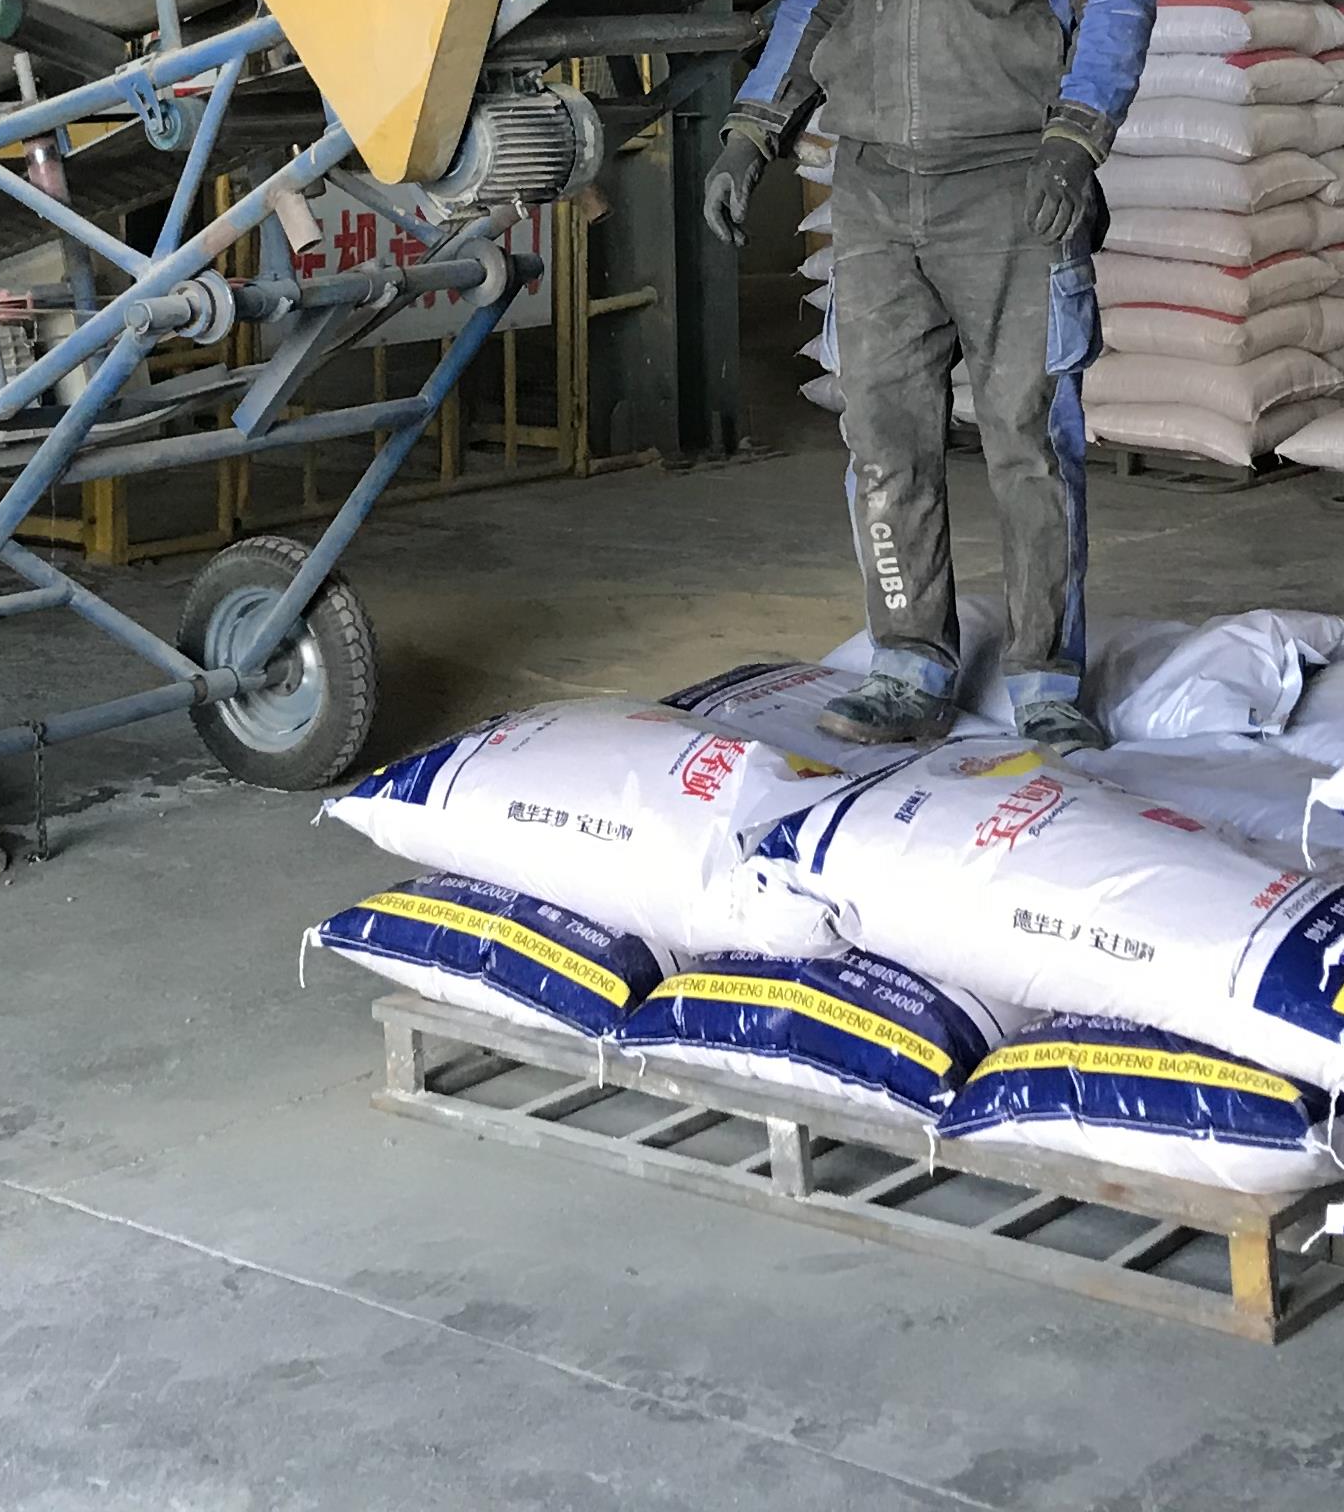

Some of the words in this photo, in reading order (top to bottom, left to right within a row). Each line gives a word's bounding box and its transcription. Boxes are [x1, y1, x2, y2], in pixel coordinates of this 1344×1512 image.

[870, 521, 907, 611] CLUBS
[507, 800, 570, 827] 德华生物
[513, 931, 561, 964] BAOFENG
[563, 956, 616, 994] BAOFENG
[710, 979, 763, 999] BAOFENG
[818, 1000, 873, 1035] BAOFENG
[875, 1024, 935, 1062] BAOFENG
[1093, 1050, 1154, 1071] BAOFENG
[1218, 1067, 1284, 1095] BAOFENG
